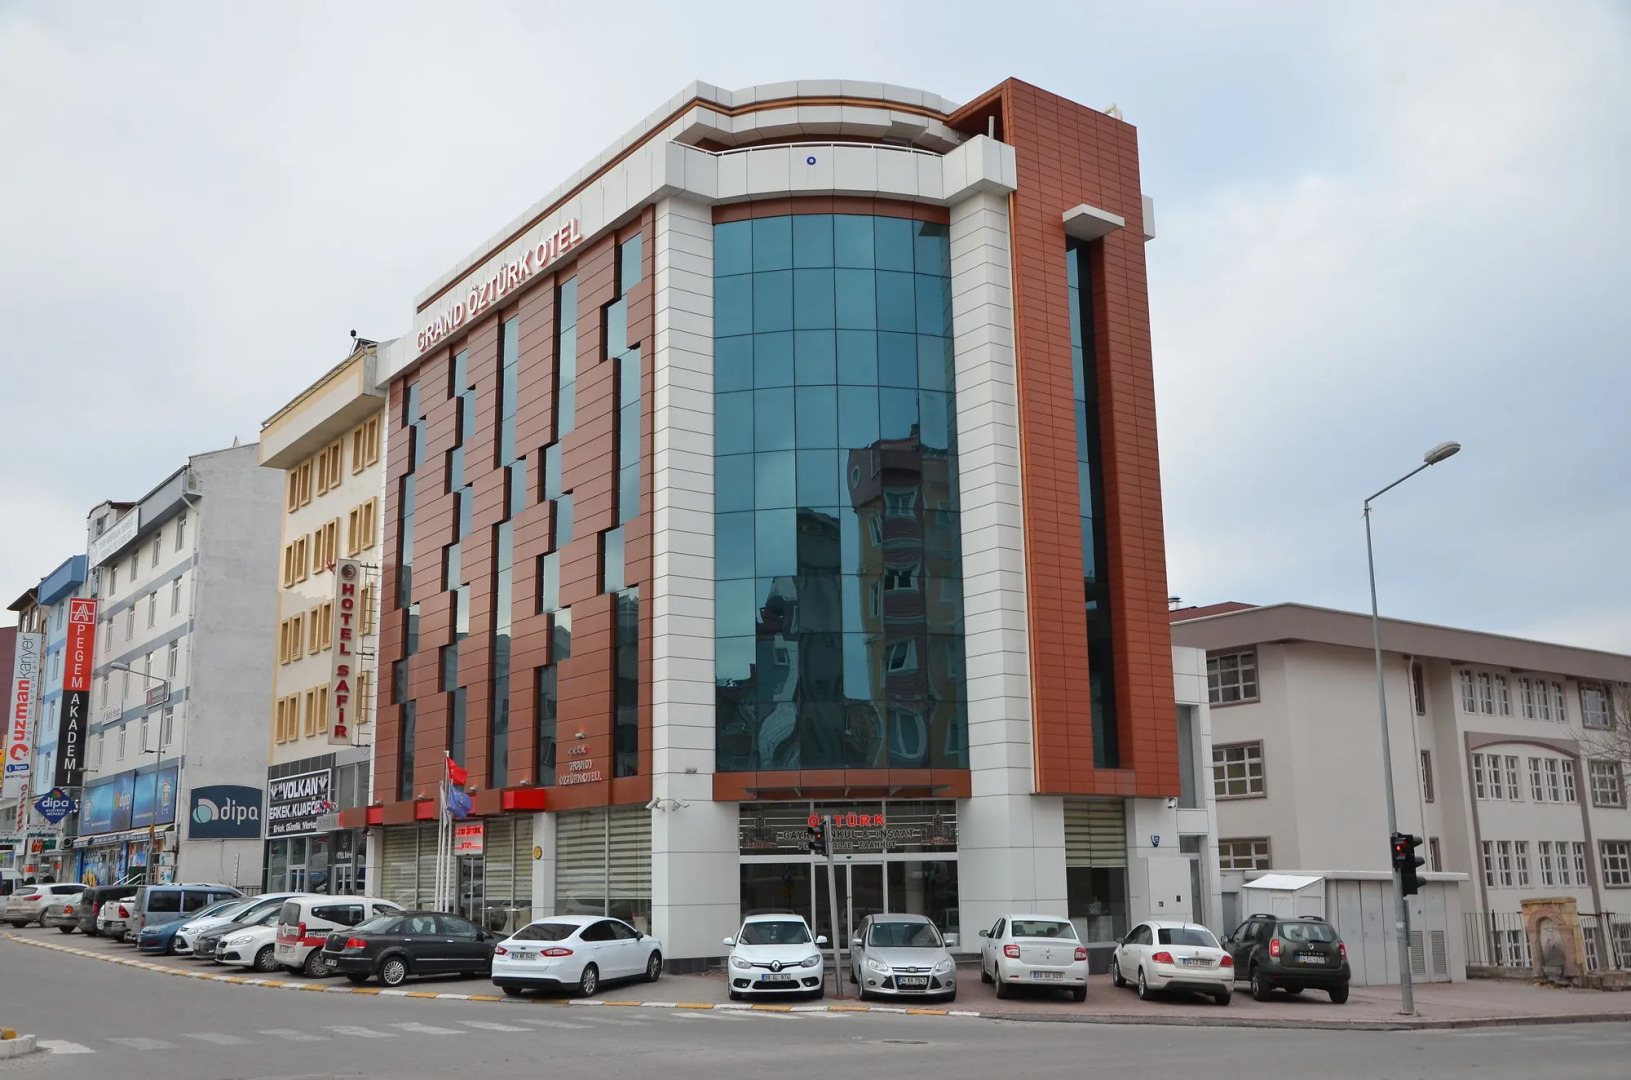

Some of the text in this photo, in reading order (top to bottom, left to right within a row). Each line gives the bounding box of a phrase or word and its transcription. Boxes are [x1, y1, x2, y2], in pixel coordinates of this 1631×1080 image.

[417, 217, 583, 351] GRAND ÖZTÜRK OTEL
[71, 625, 86, 689] PEGEM
[333, 583, 355, 739] HOTEL SAFİR
[42, 797, 69, 809] dipa
[220, 797, 259, 826] dipa
[270, 804, 291, 820] ERKEK
[808, 812, 885, 828] ÖTÜRK
[783, 829, 858, 840] GAYRNKUL
[876, 828, 914, 840] İNŞAAT
[832, 841, 853, 849] ROJE
